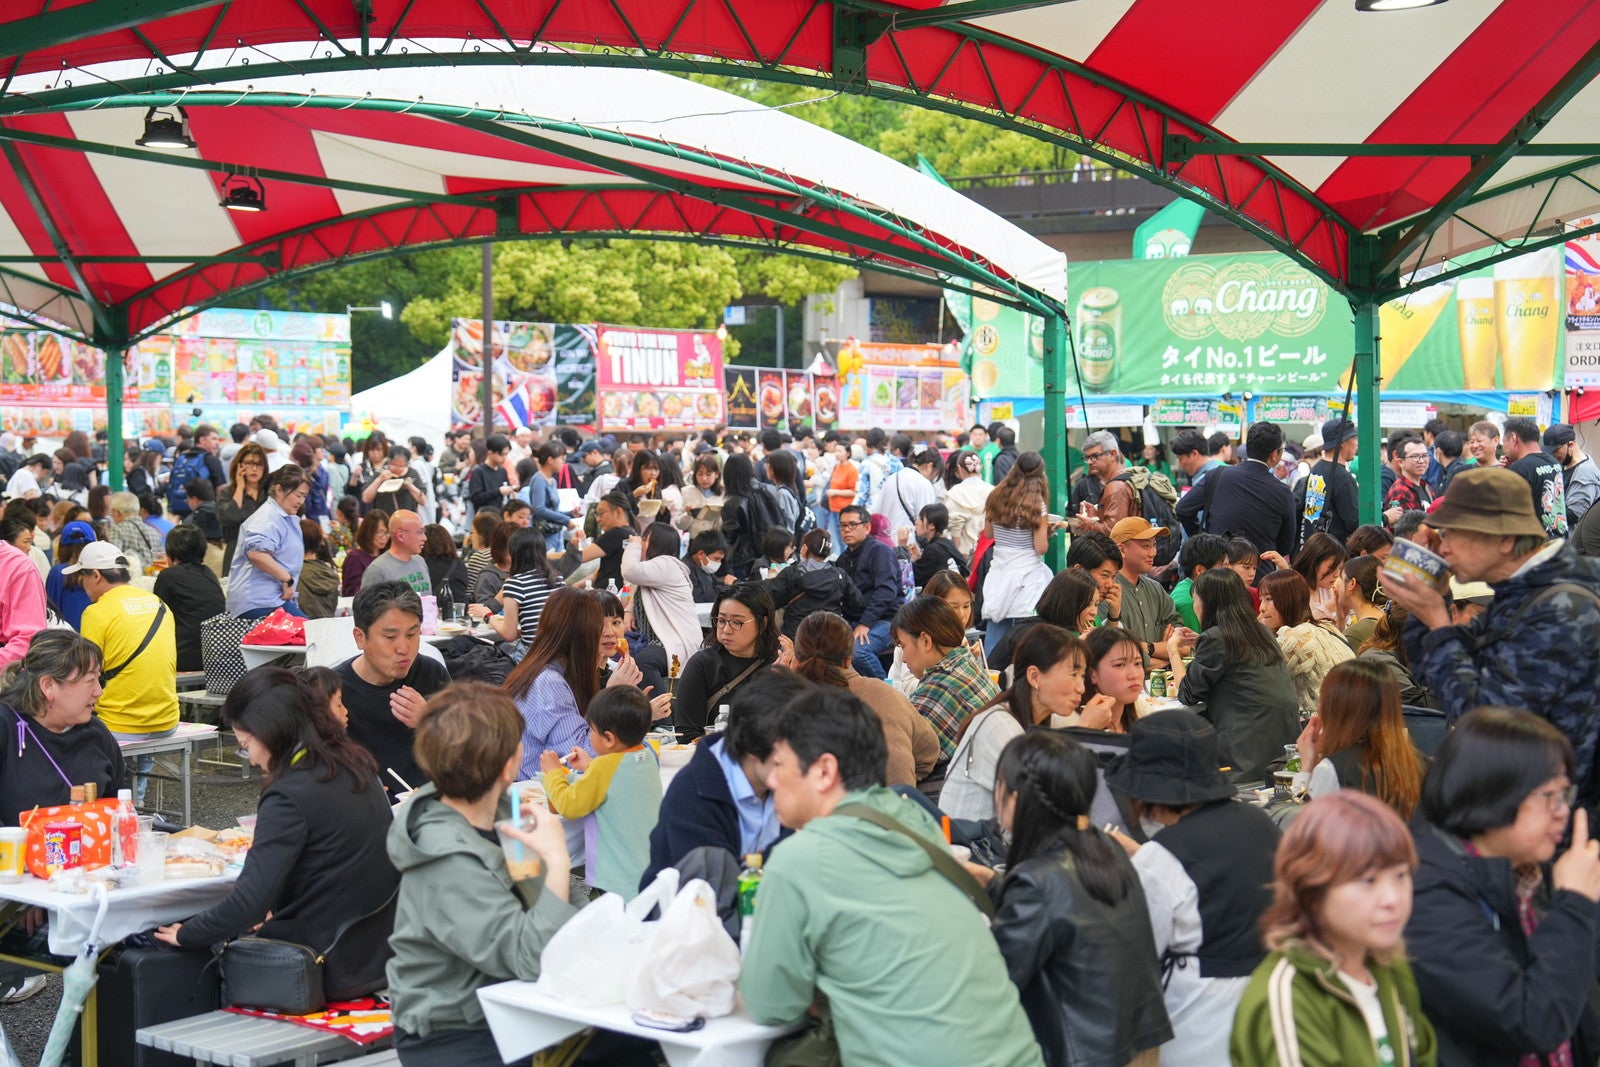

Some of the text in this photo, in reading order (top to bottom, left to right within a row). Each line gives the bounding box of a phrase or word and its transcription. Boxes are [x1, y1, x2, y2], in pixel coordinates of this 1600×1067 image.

[1216, 279, 1319, 319] Chang
[1465, 315, 1494, 326] Chang
[1506, 303, 1549, 319] Chang
[1079, 342, 1114, 360] Chang
[1162, 344, 1328, 369] タイNo.1ビール
[607, 346, 679, 386] TINUN
